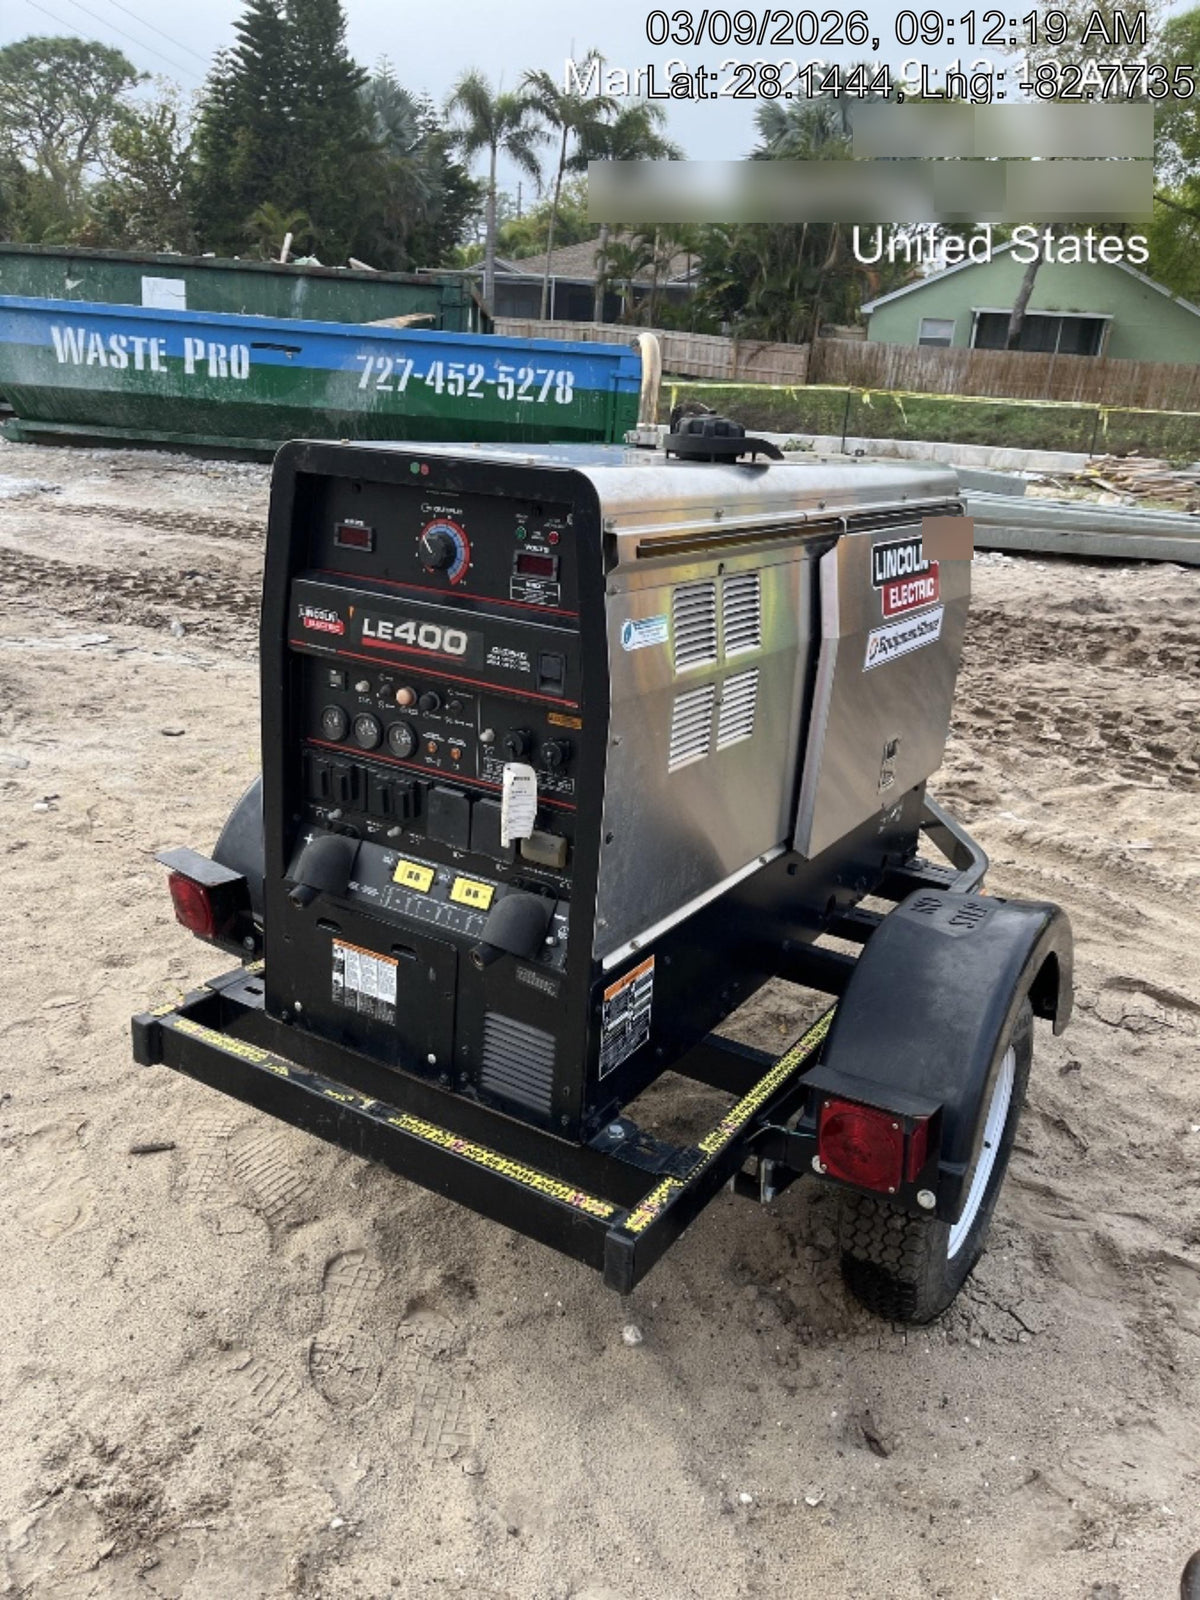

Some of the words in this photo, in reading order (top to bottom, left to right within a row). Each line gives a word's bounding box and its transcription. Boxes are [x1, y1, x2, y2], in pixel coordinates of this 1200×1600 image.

[51, 326, 167, 373] WASTE
[184, 337, 249, 379] PRO
[357, 355, 574, 404] 727-452-5278
[889, 577, 935, 609] ELECTRIC
[362, 618, 468, 655] LE400
